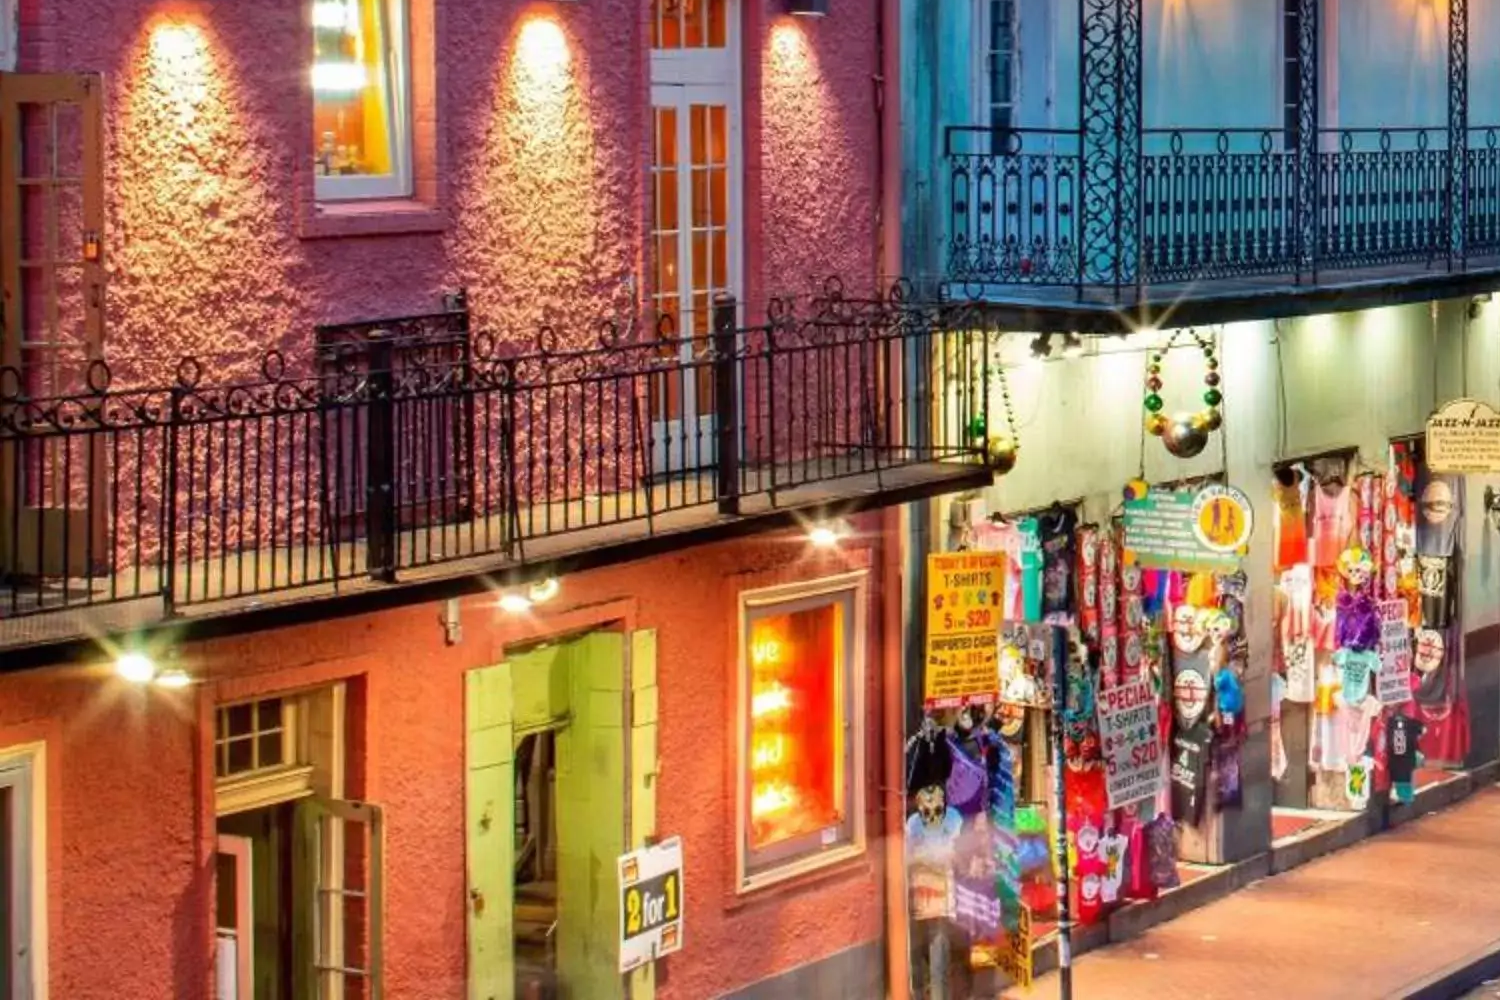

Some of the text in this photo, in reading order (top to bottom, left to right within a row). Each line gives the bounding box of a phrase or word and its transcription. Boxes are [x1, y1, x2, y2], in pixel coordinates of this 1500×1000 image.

[943, 572, 993, 588] T-SHIRTS
[944, 612, 954, 629] 5
[966, 609, 991, 628] $20
[1098, 682, 1154, 714] SPECIAL
[1105, 706, 1152, 731] T-SHIRTS
[1131, 742, 1159, 769] $20
[626, 874, 678, 936] 2 for 1
